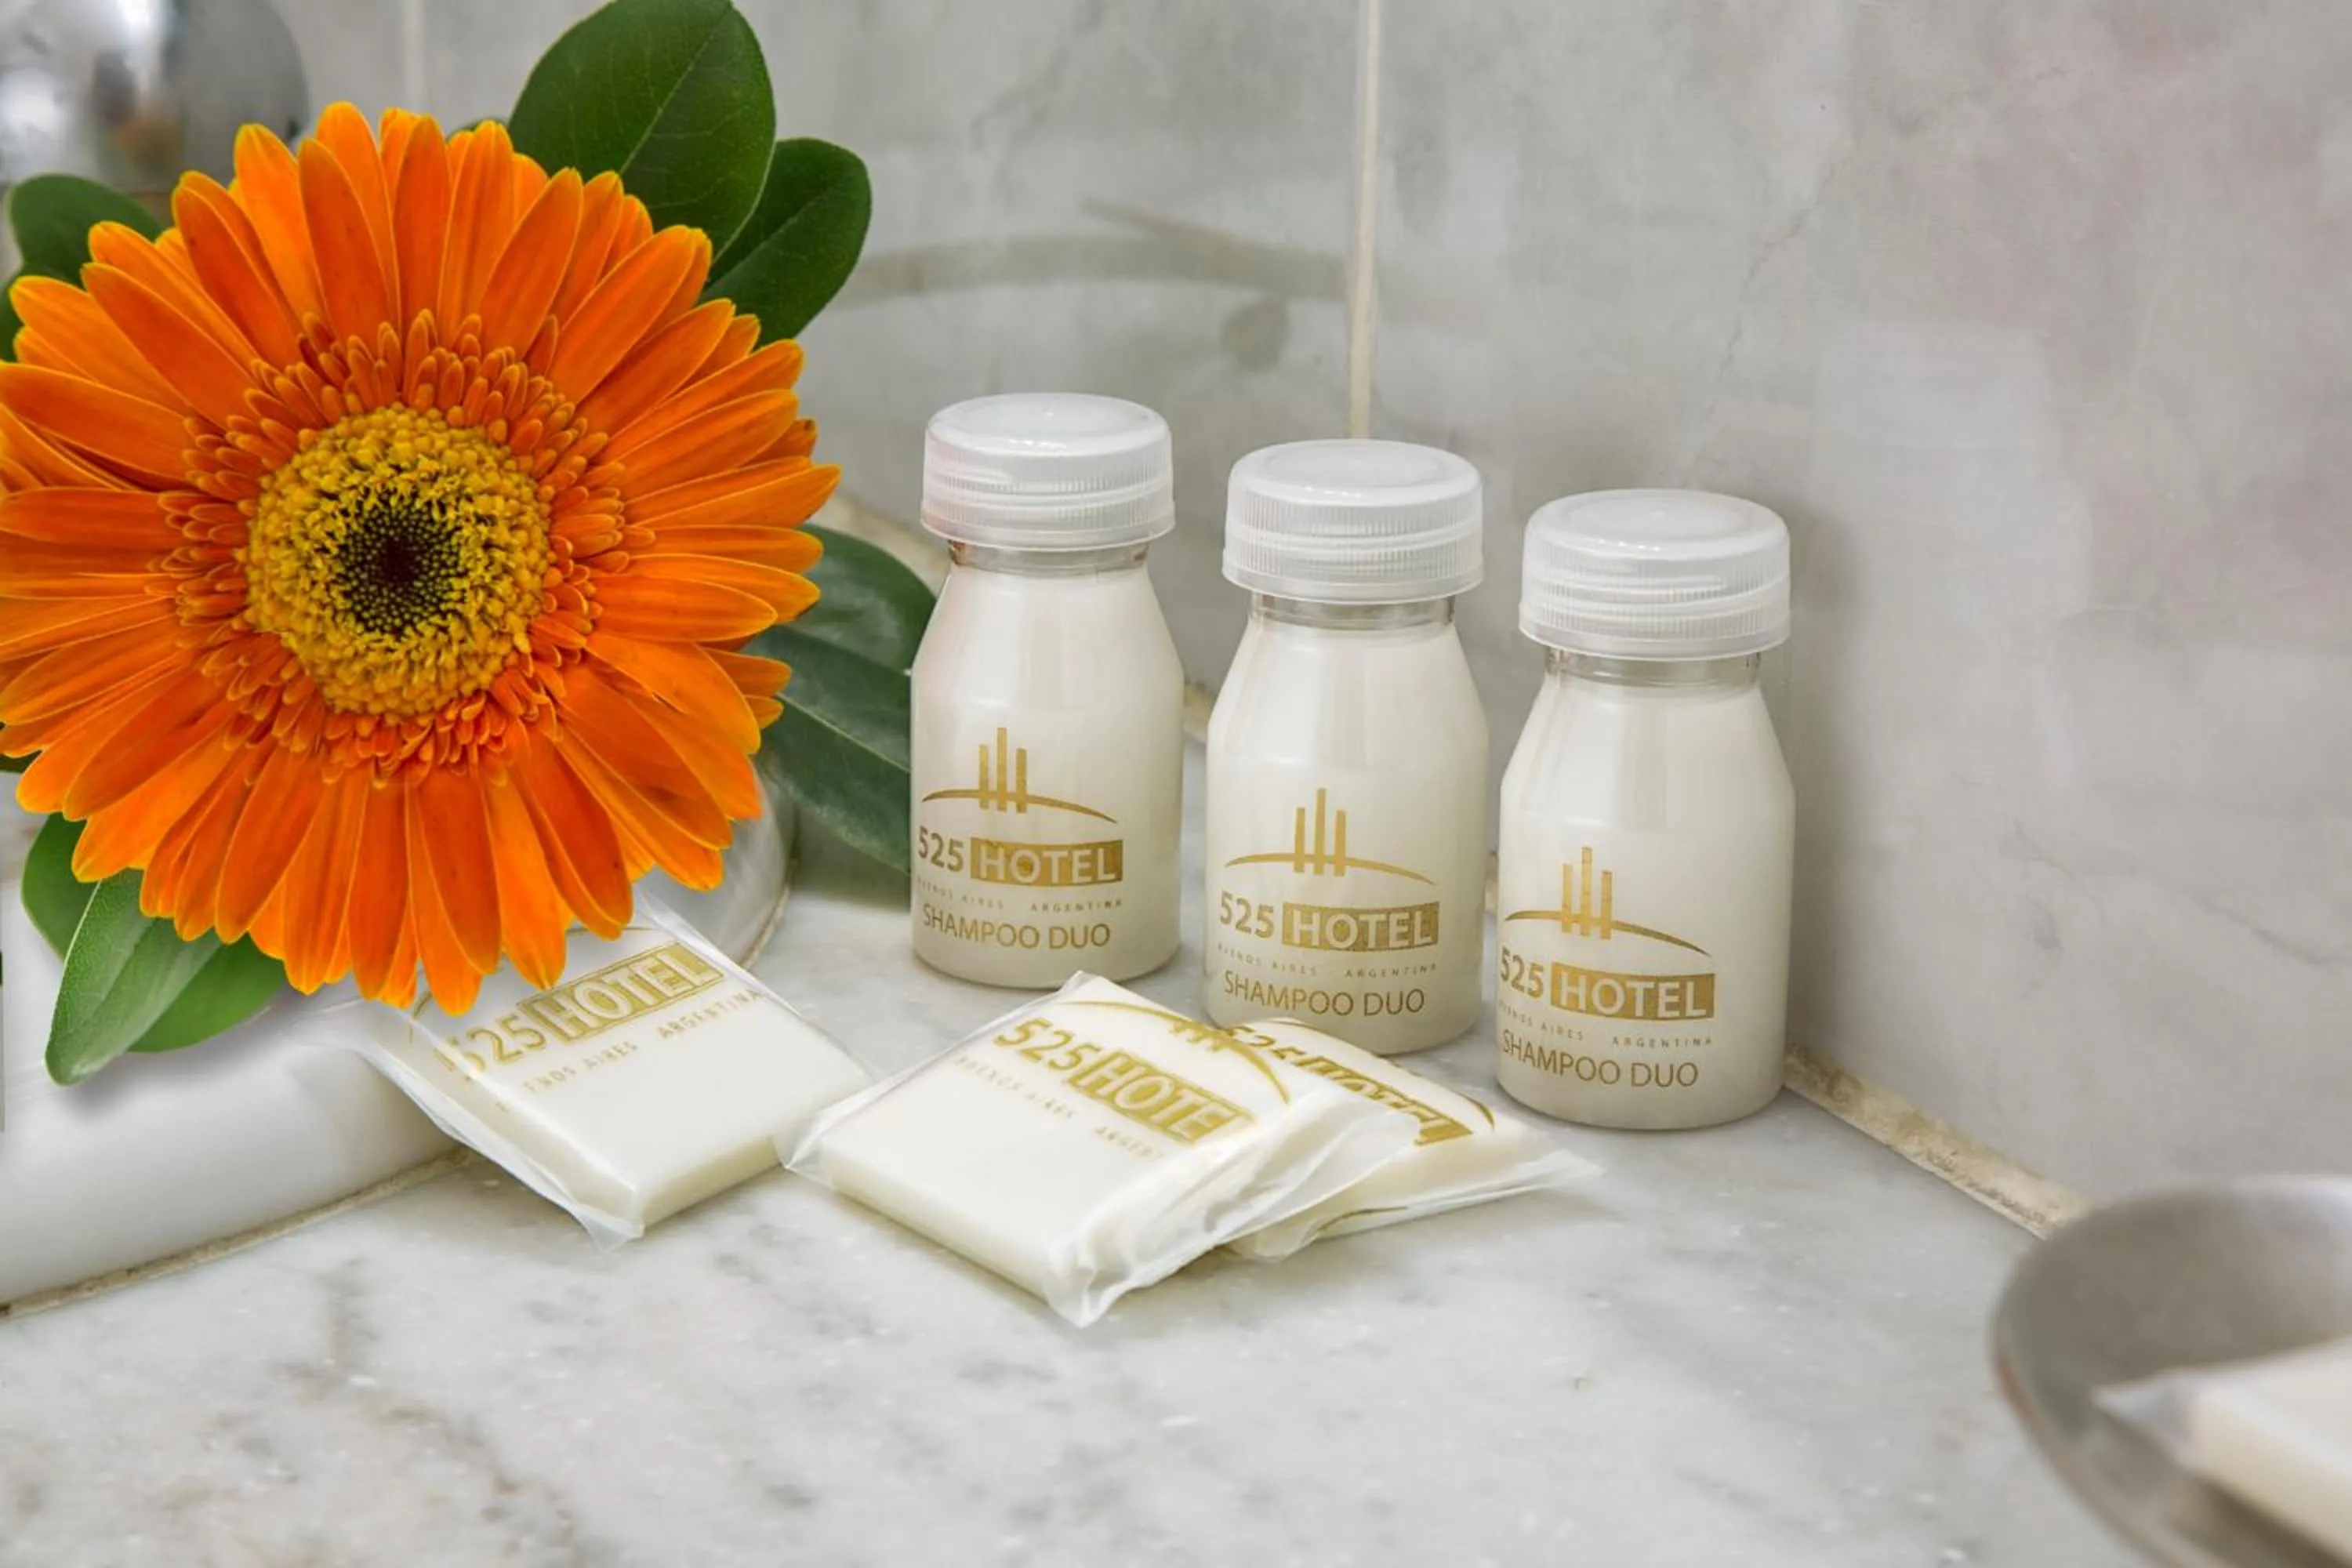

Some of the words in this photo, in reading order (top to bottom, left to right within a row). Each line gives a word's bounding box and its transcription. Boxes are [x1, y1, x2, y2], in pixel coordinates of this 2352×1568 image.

[918, 826, 964, 873] 525
[980, 844, 1116, 884] HOTEL
[923, 902, 1040, 949] SHAMPOO
[1048, 923, 1111, 950] DUO
[1219, 890, 1275, 940] 525
[1294, 904, 1433, 950] HOTEL
[532, 951, 723, 1038] HOTEL
[1224, 969, 1355, 1017] SHAMPOO
[1363, 988, 1425, 1017] DUO
[1500, 946, 1544, 1000] 525
[1559, 971, 1707, 1018] HOTEL
[993, 1017, 1101, 1072] 525
[1078, 1055, 1240, 1142] HOTE
[1502, 1028, 1621, 1085] SHAMPOO
[1631, 1062, 1699, 1088] DUO
